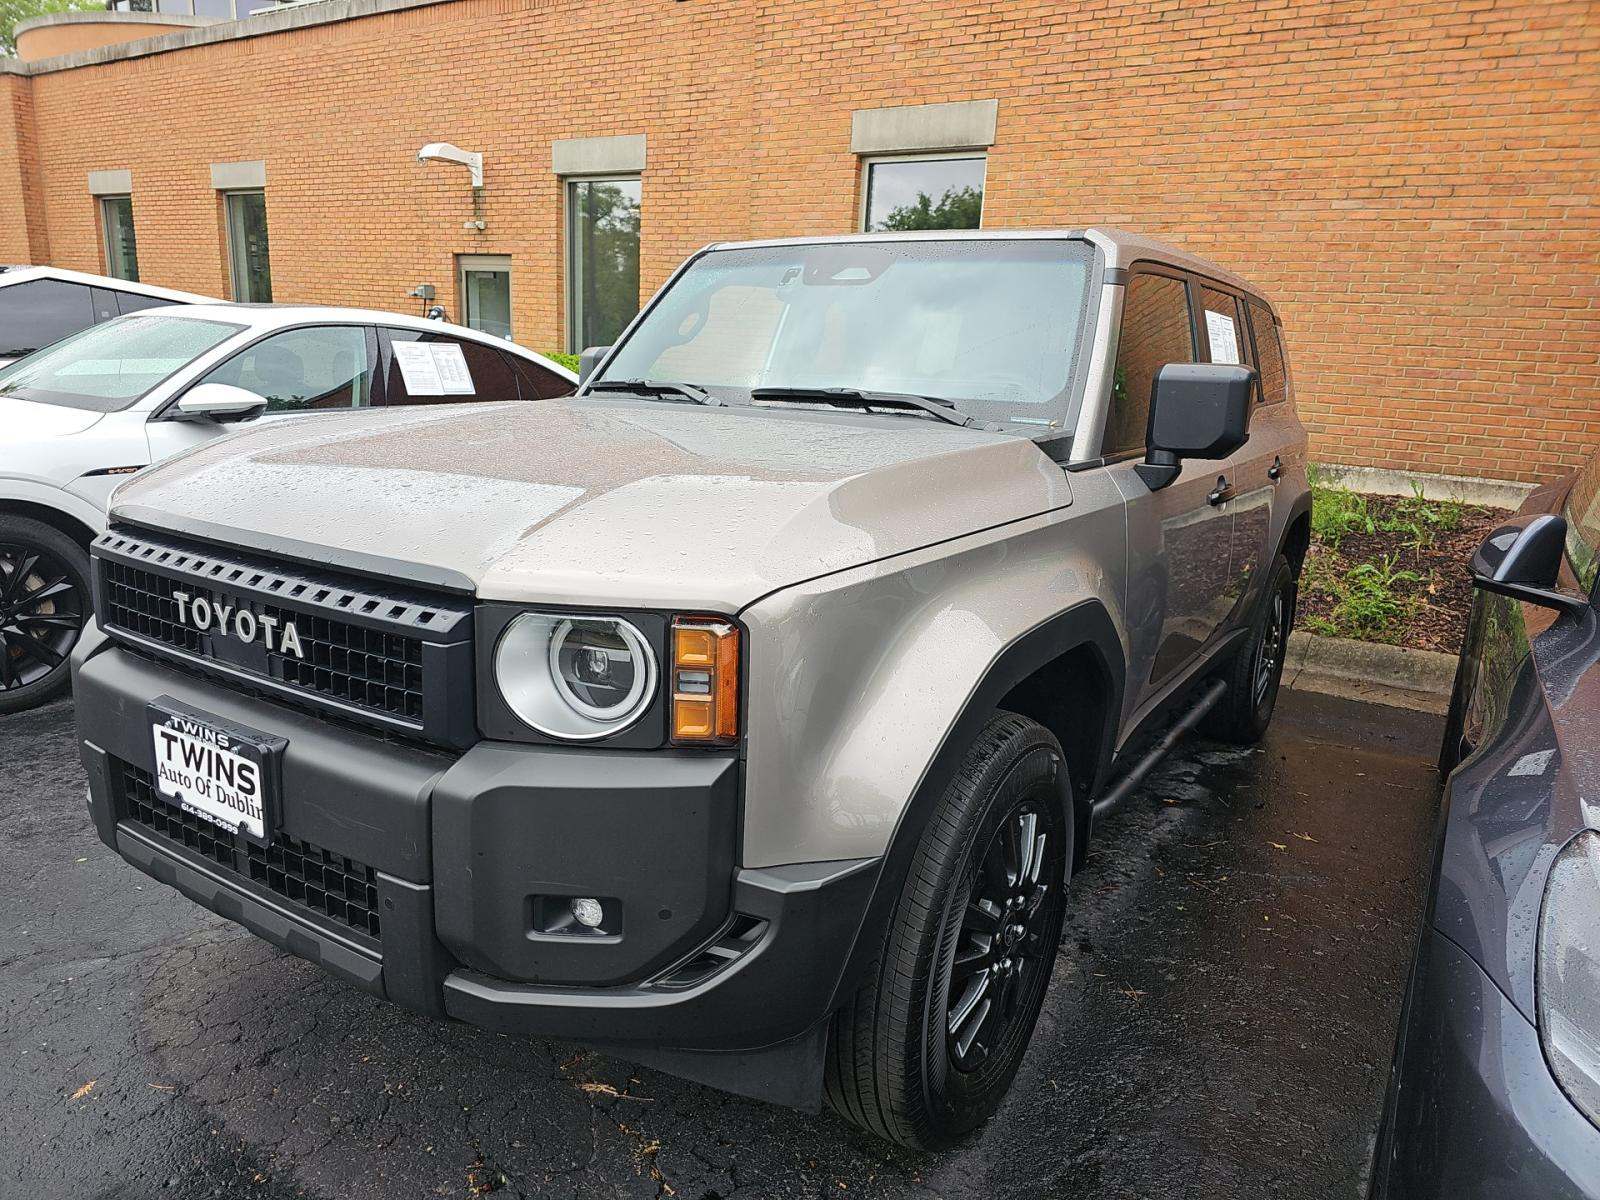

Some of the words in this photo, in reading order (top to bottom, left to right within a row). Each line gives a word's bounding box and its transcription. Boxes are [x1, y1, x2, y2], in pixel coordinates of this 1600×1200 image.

[173, 591, 304, 658] TOYOTA
[171, 716, 230, 747] TWINS
[159, 761, 192, 789] Auto
[196, 776, 211, 798] Of
[161, 731, 255, 796] TWINS
